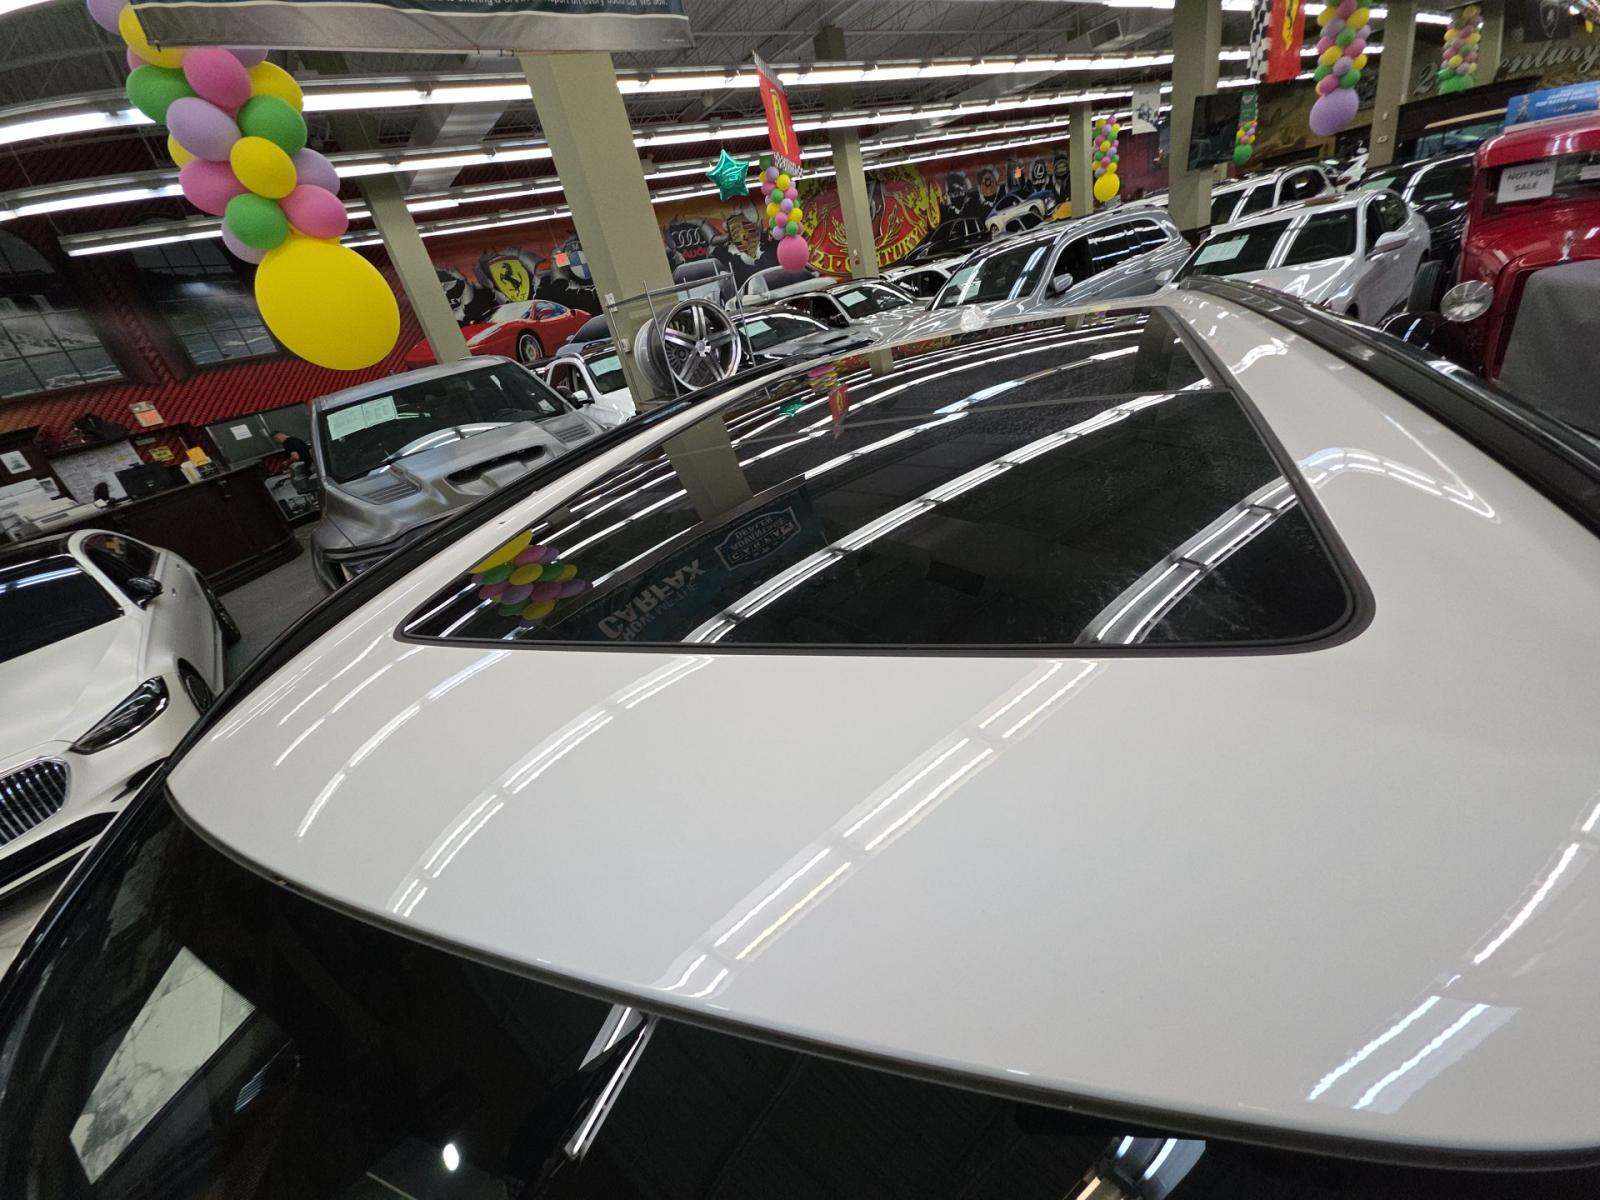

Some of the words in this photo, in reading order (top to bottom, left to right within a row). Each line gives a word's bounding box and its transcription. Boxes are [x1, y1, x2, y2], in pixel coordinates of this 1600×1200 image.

[1501, 40, 1600, 74] entury
[1508, 171, 1527, 181] NOT
[1530, 168, 1551, 178] FOR
[1515, 182, 1538, 192] SALE
